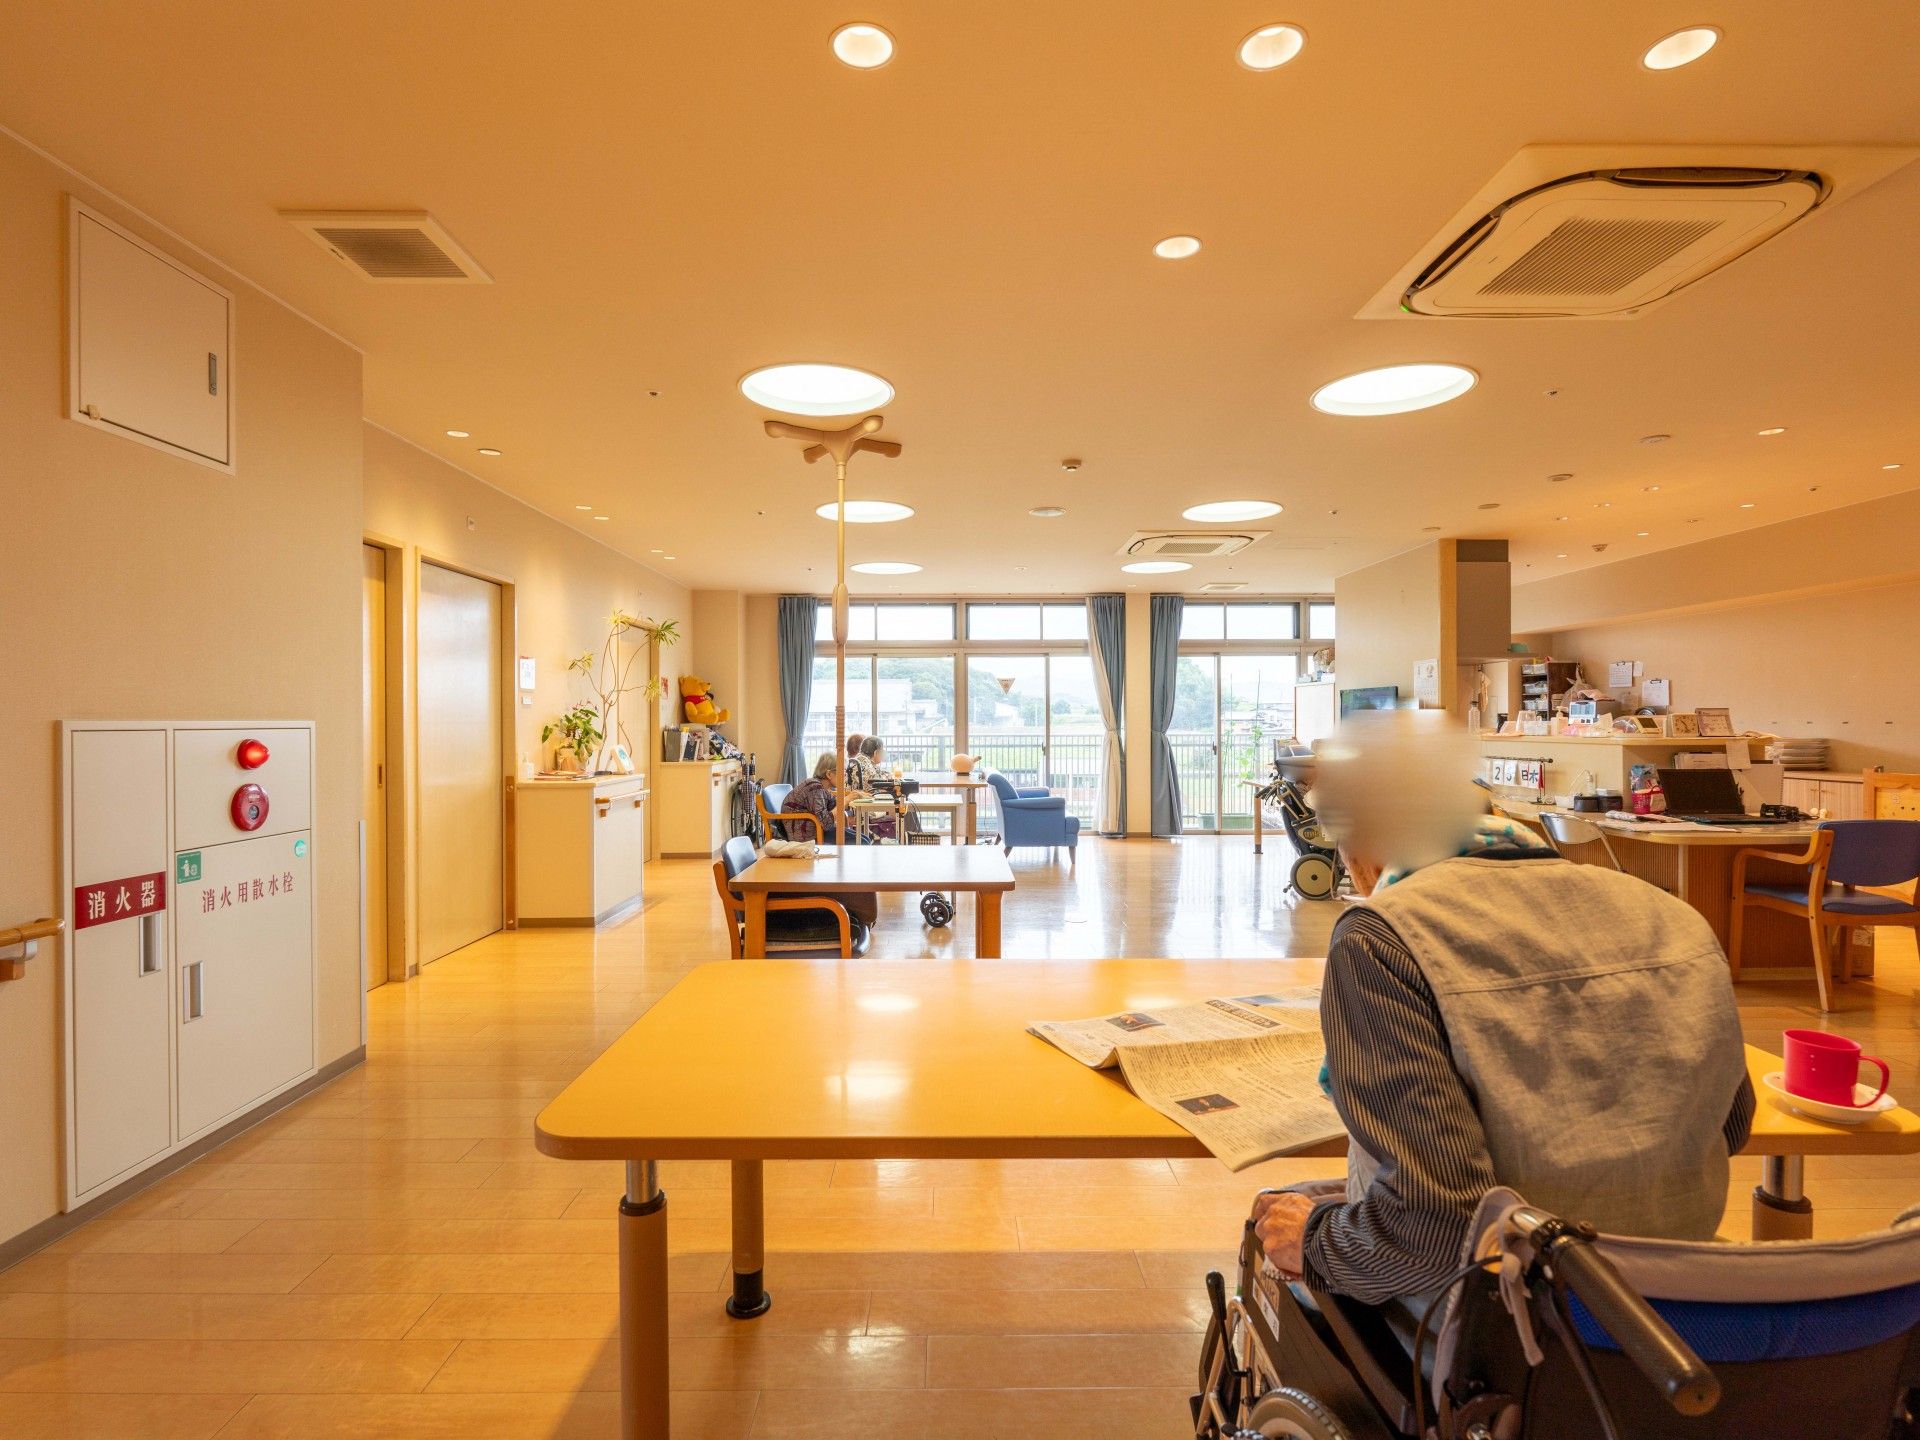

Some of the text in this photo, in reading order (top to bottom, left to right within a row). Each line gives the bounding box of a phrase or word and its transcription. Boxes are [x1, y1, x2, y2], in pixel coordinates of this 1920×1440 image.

[87, 880, 156, 920] 消火器
[202, 871, 294, 913] 消火用散水栓
